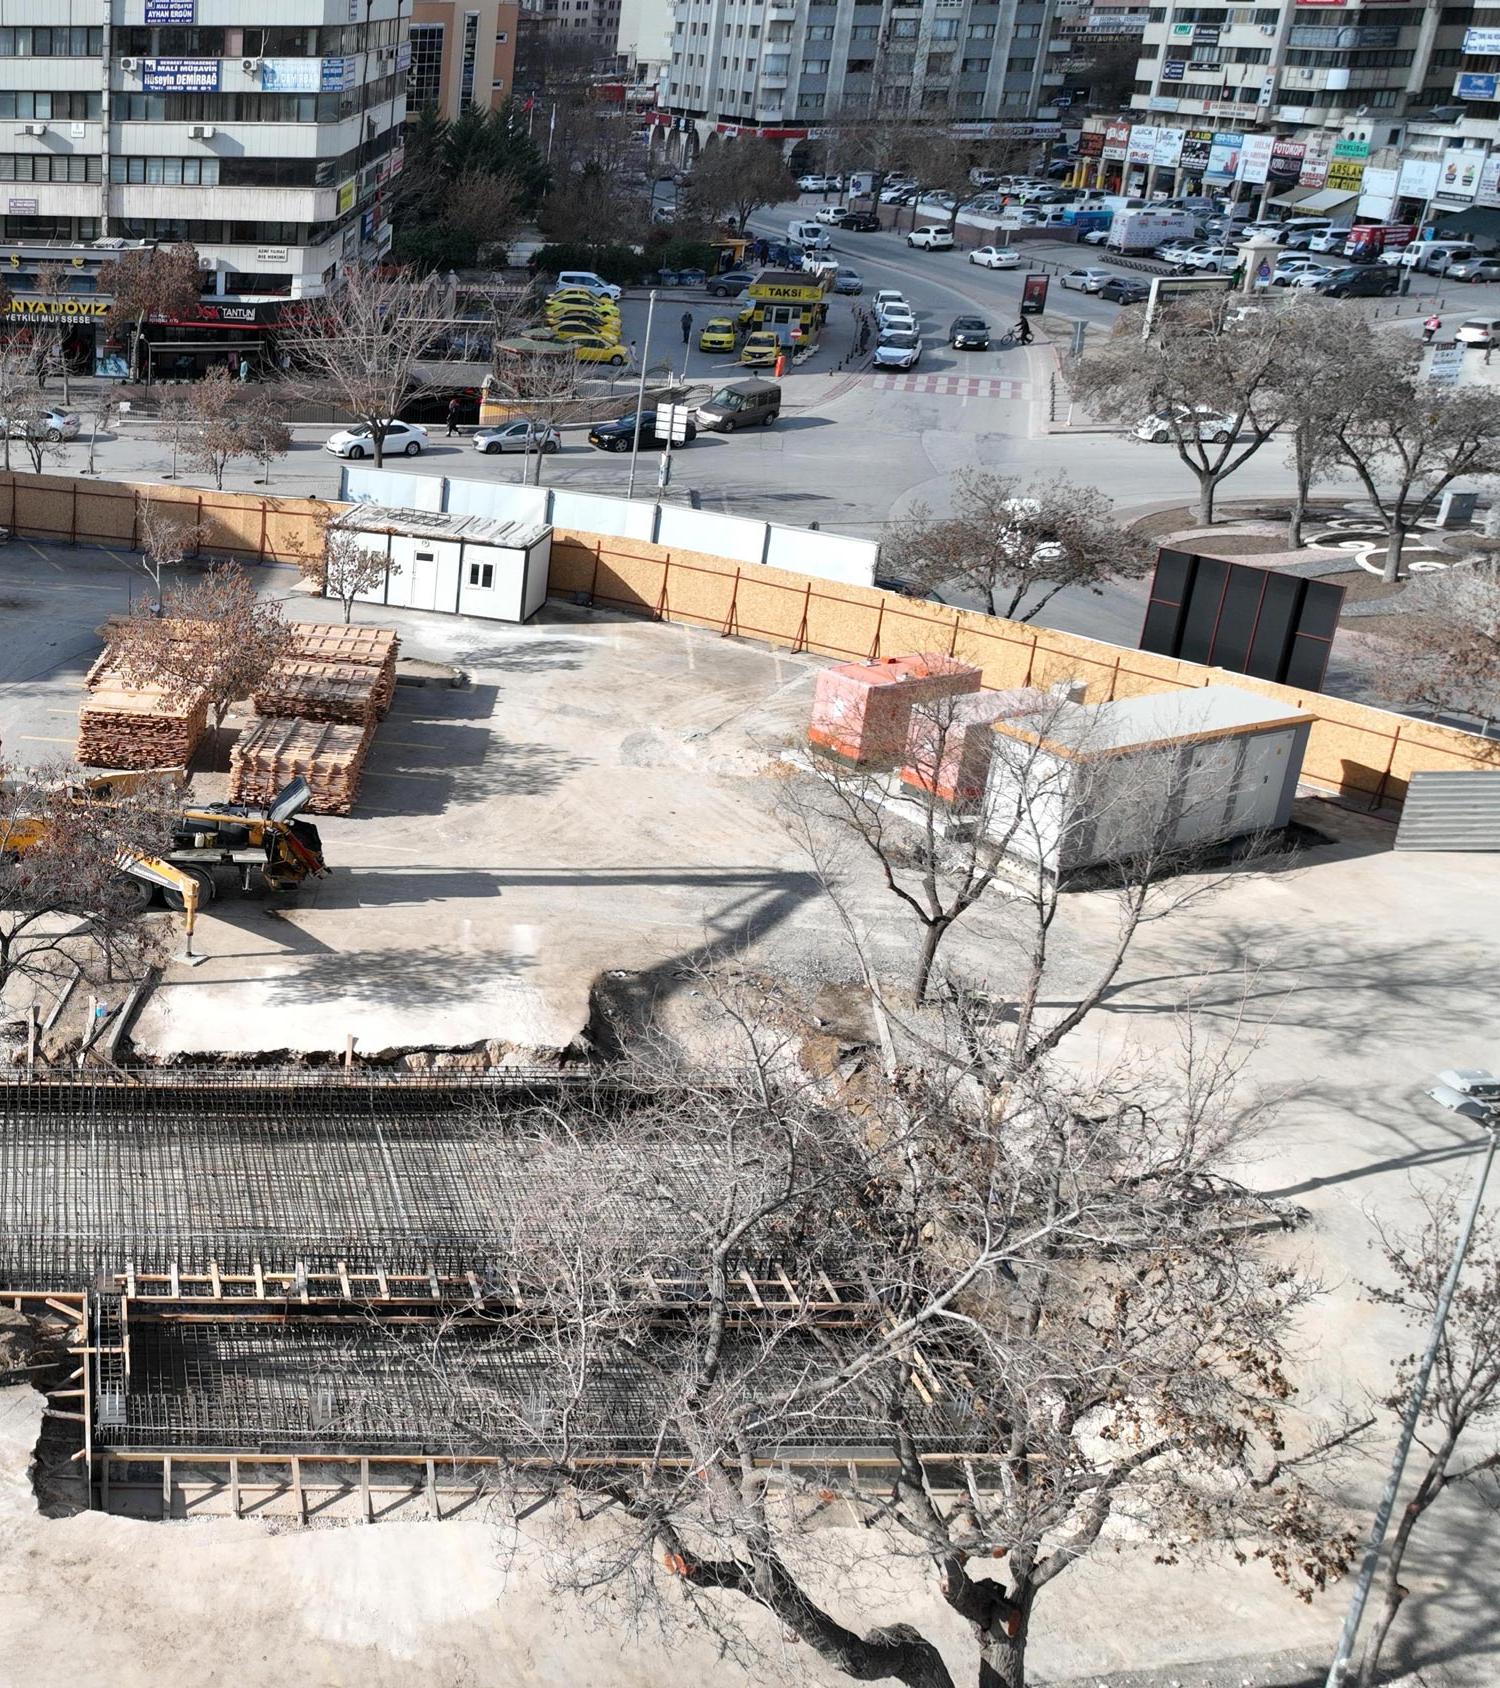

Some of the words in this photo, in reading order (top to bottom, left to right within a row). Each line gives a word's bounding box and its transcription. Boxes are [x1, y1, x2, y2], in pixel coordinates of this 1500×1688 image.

[180, 65, 217, 73] MÜŞAVİR
[144, 73, 174, 86] Hüseyin
[176, 72, 217, 85] DEMİRBAĞ
[768, 288, 802, 297] TAKSİ
